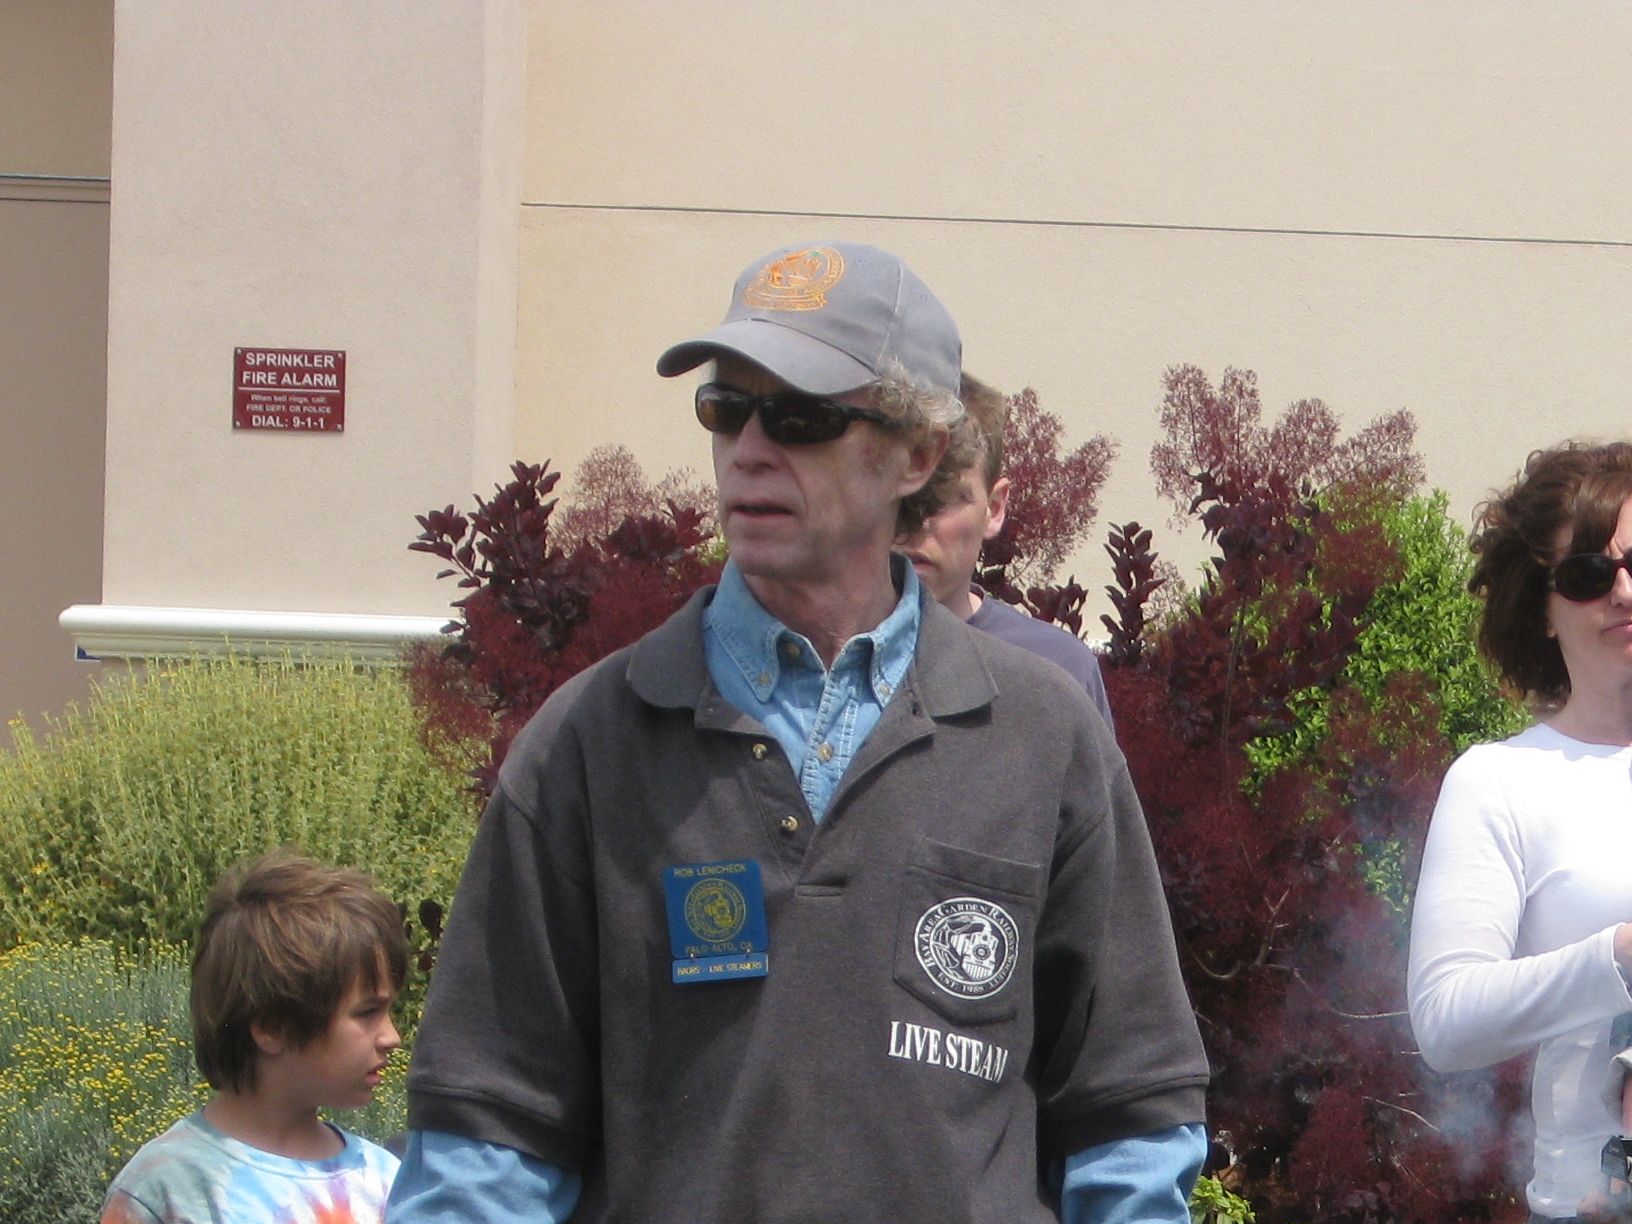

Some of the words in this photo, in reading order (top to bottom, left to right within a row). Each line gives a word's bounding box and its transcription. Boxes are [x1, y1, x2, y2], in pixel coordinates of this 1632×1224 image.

[245, 352, 335, 368] SPRINKLER
[242, 371, 277, 385] FIRE
[281, 373, 337, 387] ALARM
[246, 404, 264, 412] FIRE
[302, 406, 332, 414] POLICE
[252, 415, 289, 427] DIAL:
[292, 416, 325, 429] 9-1-1
[921, 945, 936, 968] BAY
[938, 903, 988, 917] GARDEN
[989, 907, 1016, 952] RAILWAY
[888, 1020, 941, 1065] LIVE
[945, 1032, 1009, 1083] STEAM
